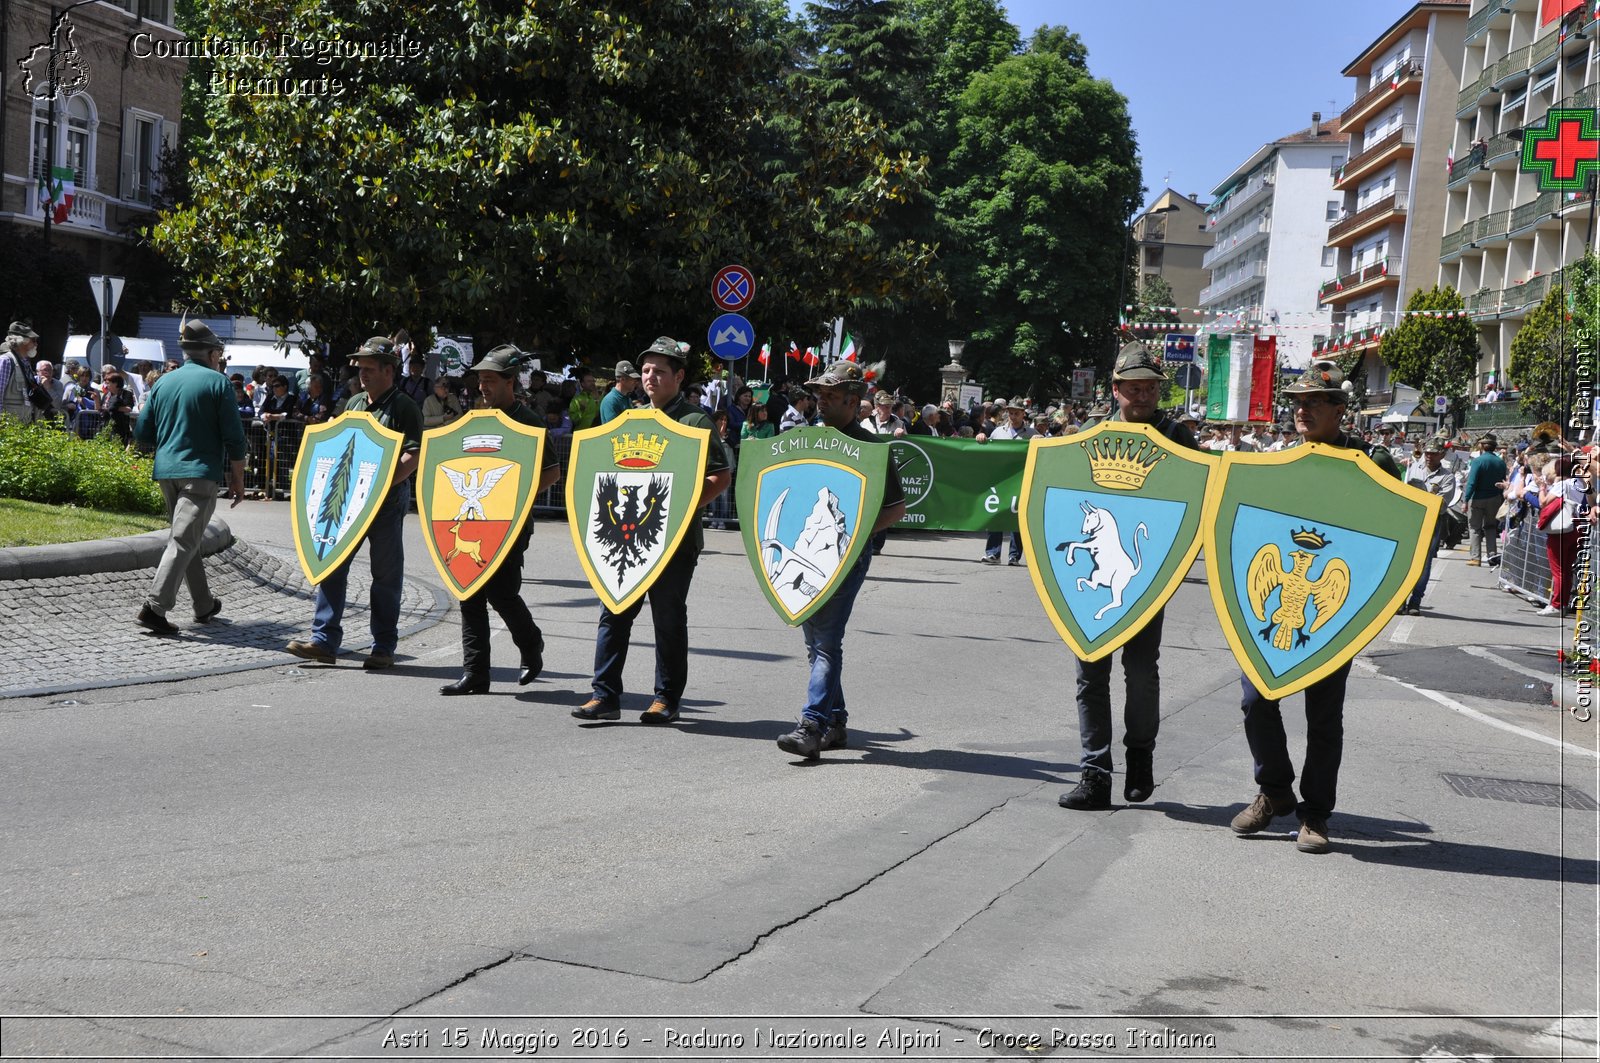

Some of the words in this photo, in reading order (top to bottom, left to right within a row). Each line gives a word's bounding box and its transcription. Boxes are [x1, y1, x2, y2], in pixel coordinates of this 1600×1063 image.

[789, 437, 809, 450] MIL
[813, 438, 860, 460] ALPINA
[984, 486, 1000, 513] è
